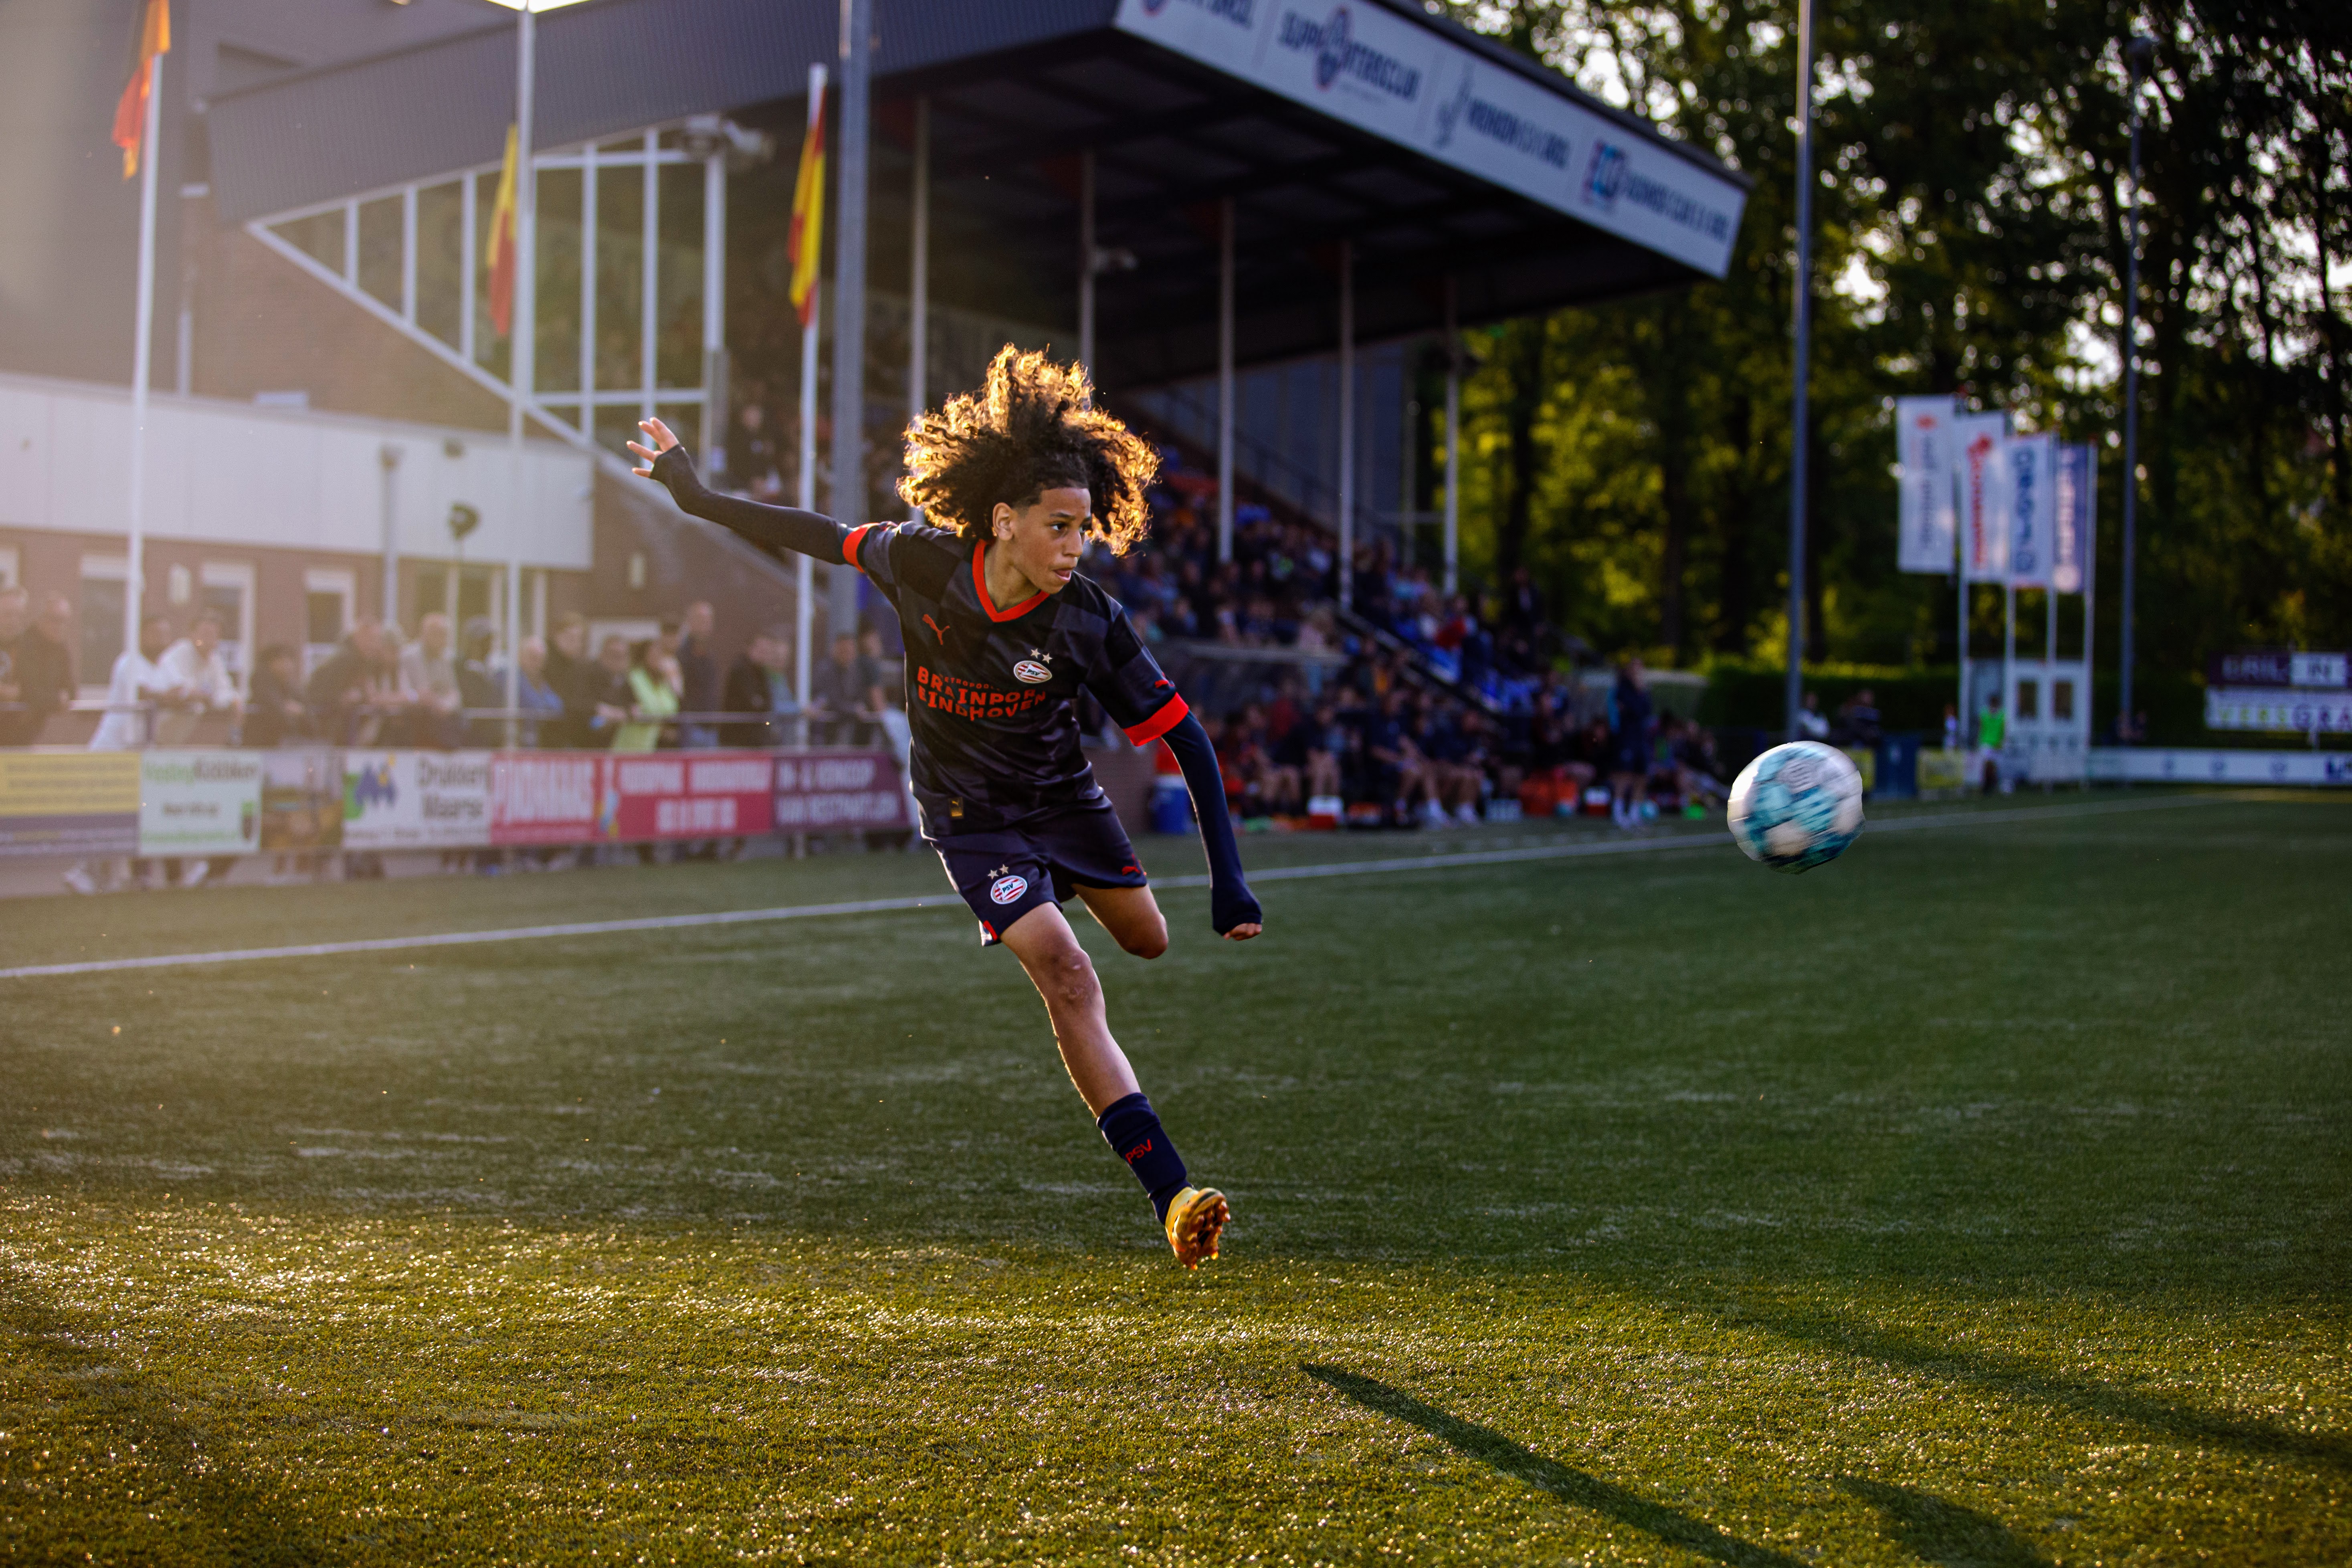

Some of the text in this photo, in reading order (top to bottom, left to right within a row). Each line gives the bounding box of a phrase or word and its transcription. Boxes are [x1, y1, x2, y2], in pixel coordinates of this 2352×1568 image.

[917, 666, 1036, 706] BRAINPOR
[918, 684, 1046, 721] EINDHOVEN
[1002, 883, 1013, 893] PSV
[1125, 1139, 1152, 1165] PSV
